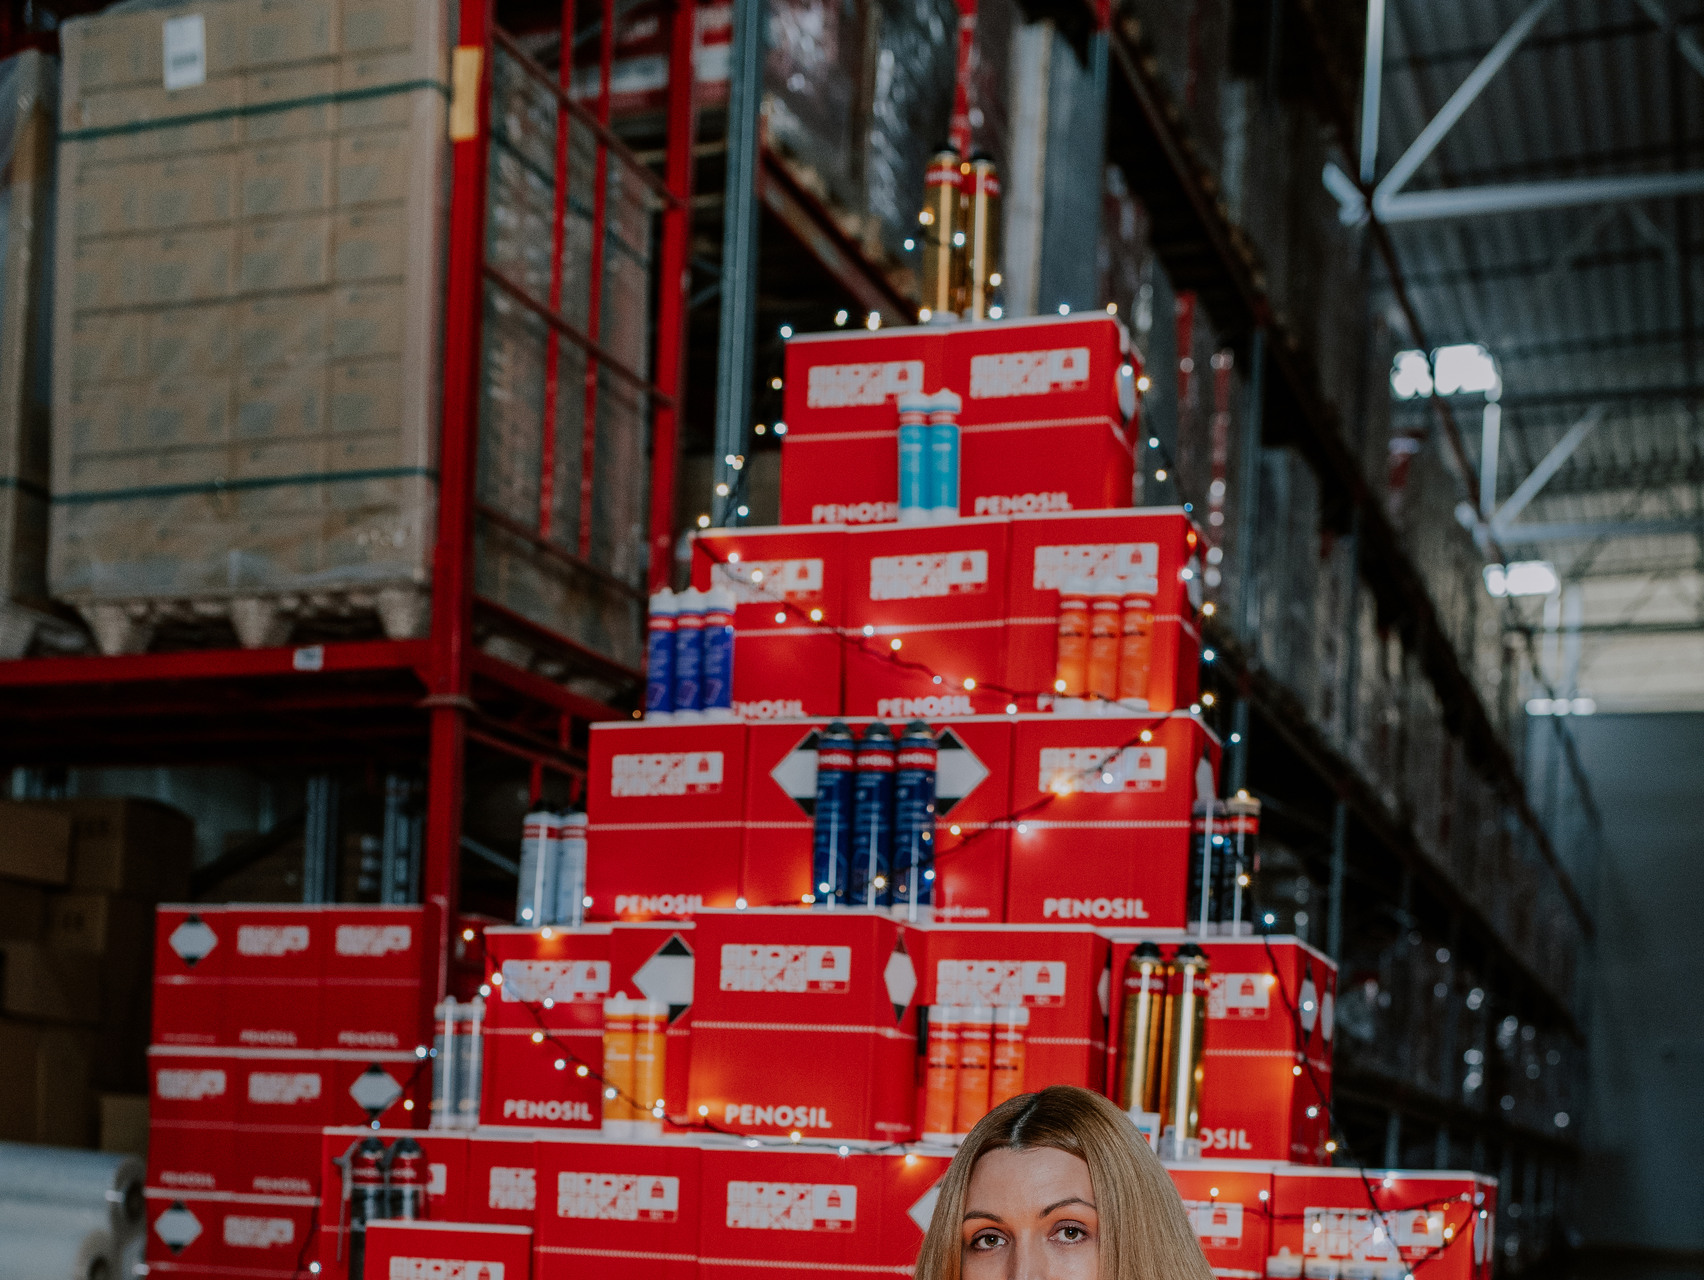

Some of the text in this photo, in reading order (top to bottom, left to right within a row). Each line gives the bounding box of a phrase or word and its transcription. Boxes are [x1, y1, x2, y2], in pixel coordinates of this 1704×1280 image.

[975, 492, 1073, 517] PENOSIL
[878, 696, 975, 720] PENOSIL
[615, 894, 707, 915] PENOSIL
[1043, 898, 1149, 919] PENOSIL
[503, 1098, 593, 1122] PENOSIL
[725, 1104, 832, 1129] PENOSIL
